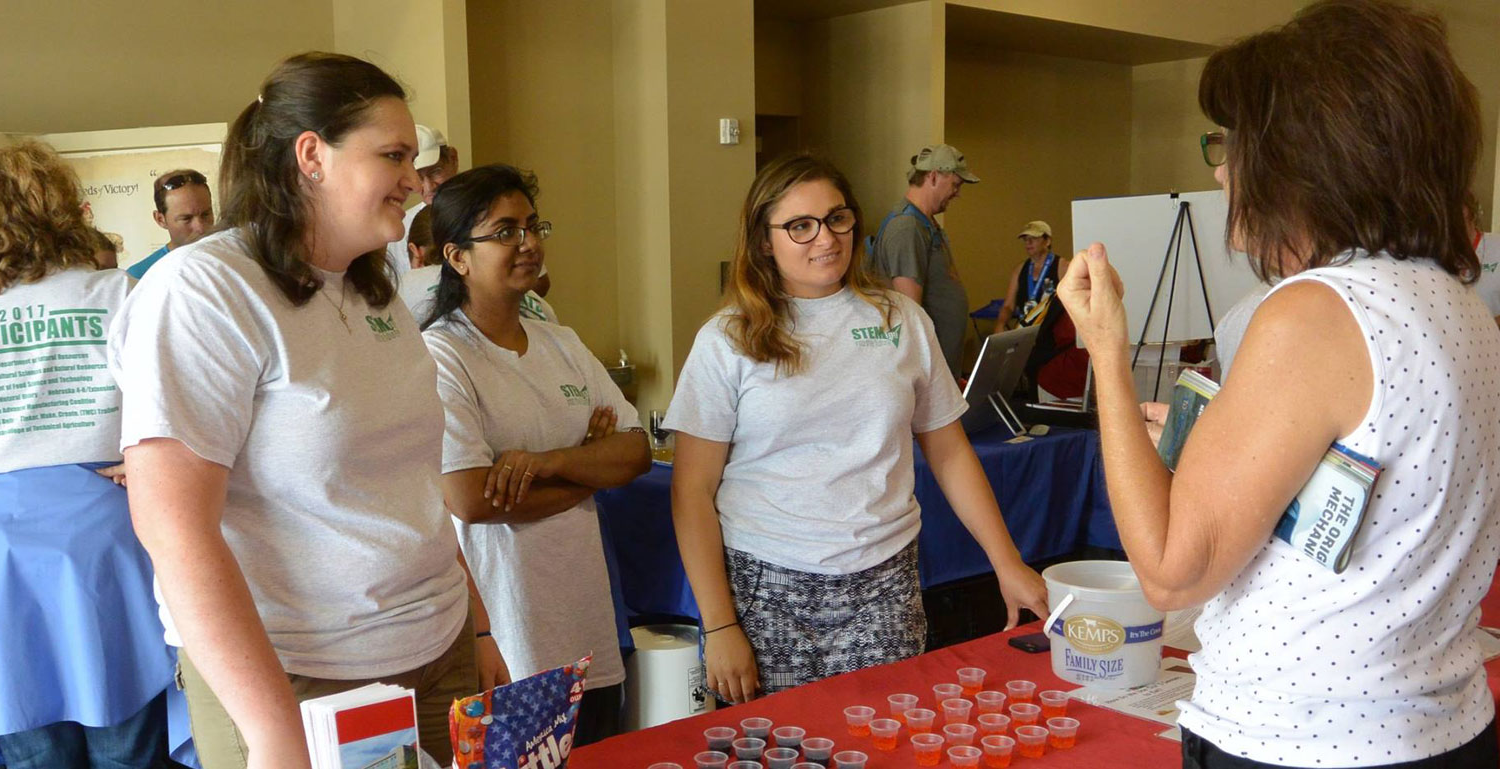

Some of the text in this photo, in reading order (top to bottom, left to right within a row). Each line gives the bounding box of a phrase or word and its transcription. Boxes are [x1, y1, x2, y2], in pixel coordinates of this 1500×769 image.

[104, 183, 138, 196] Victory!
[0, 304, 45, 322] 2017
[1303, 486, 1343, 557] MECHANI
[1316, 496, 1356, 564] THE ORIG
[1067, 623, 1120, 643] KEMPS
[1065, 648, 1125, 679] FAMILY SIZE
